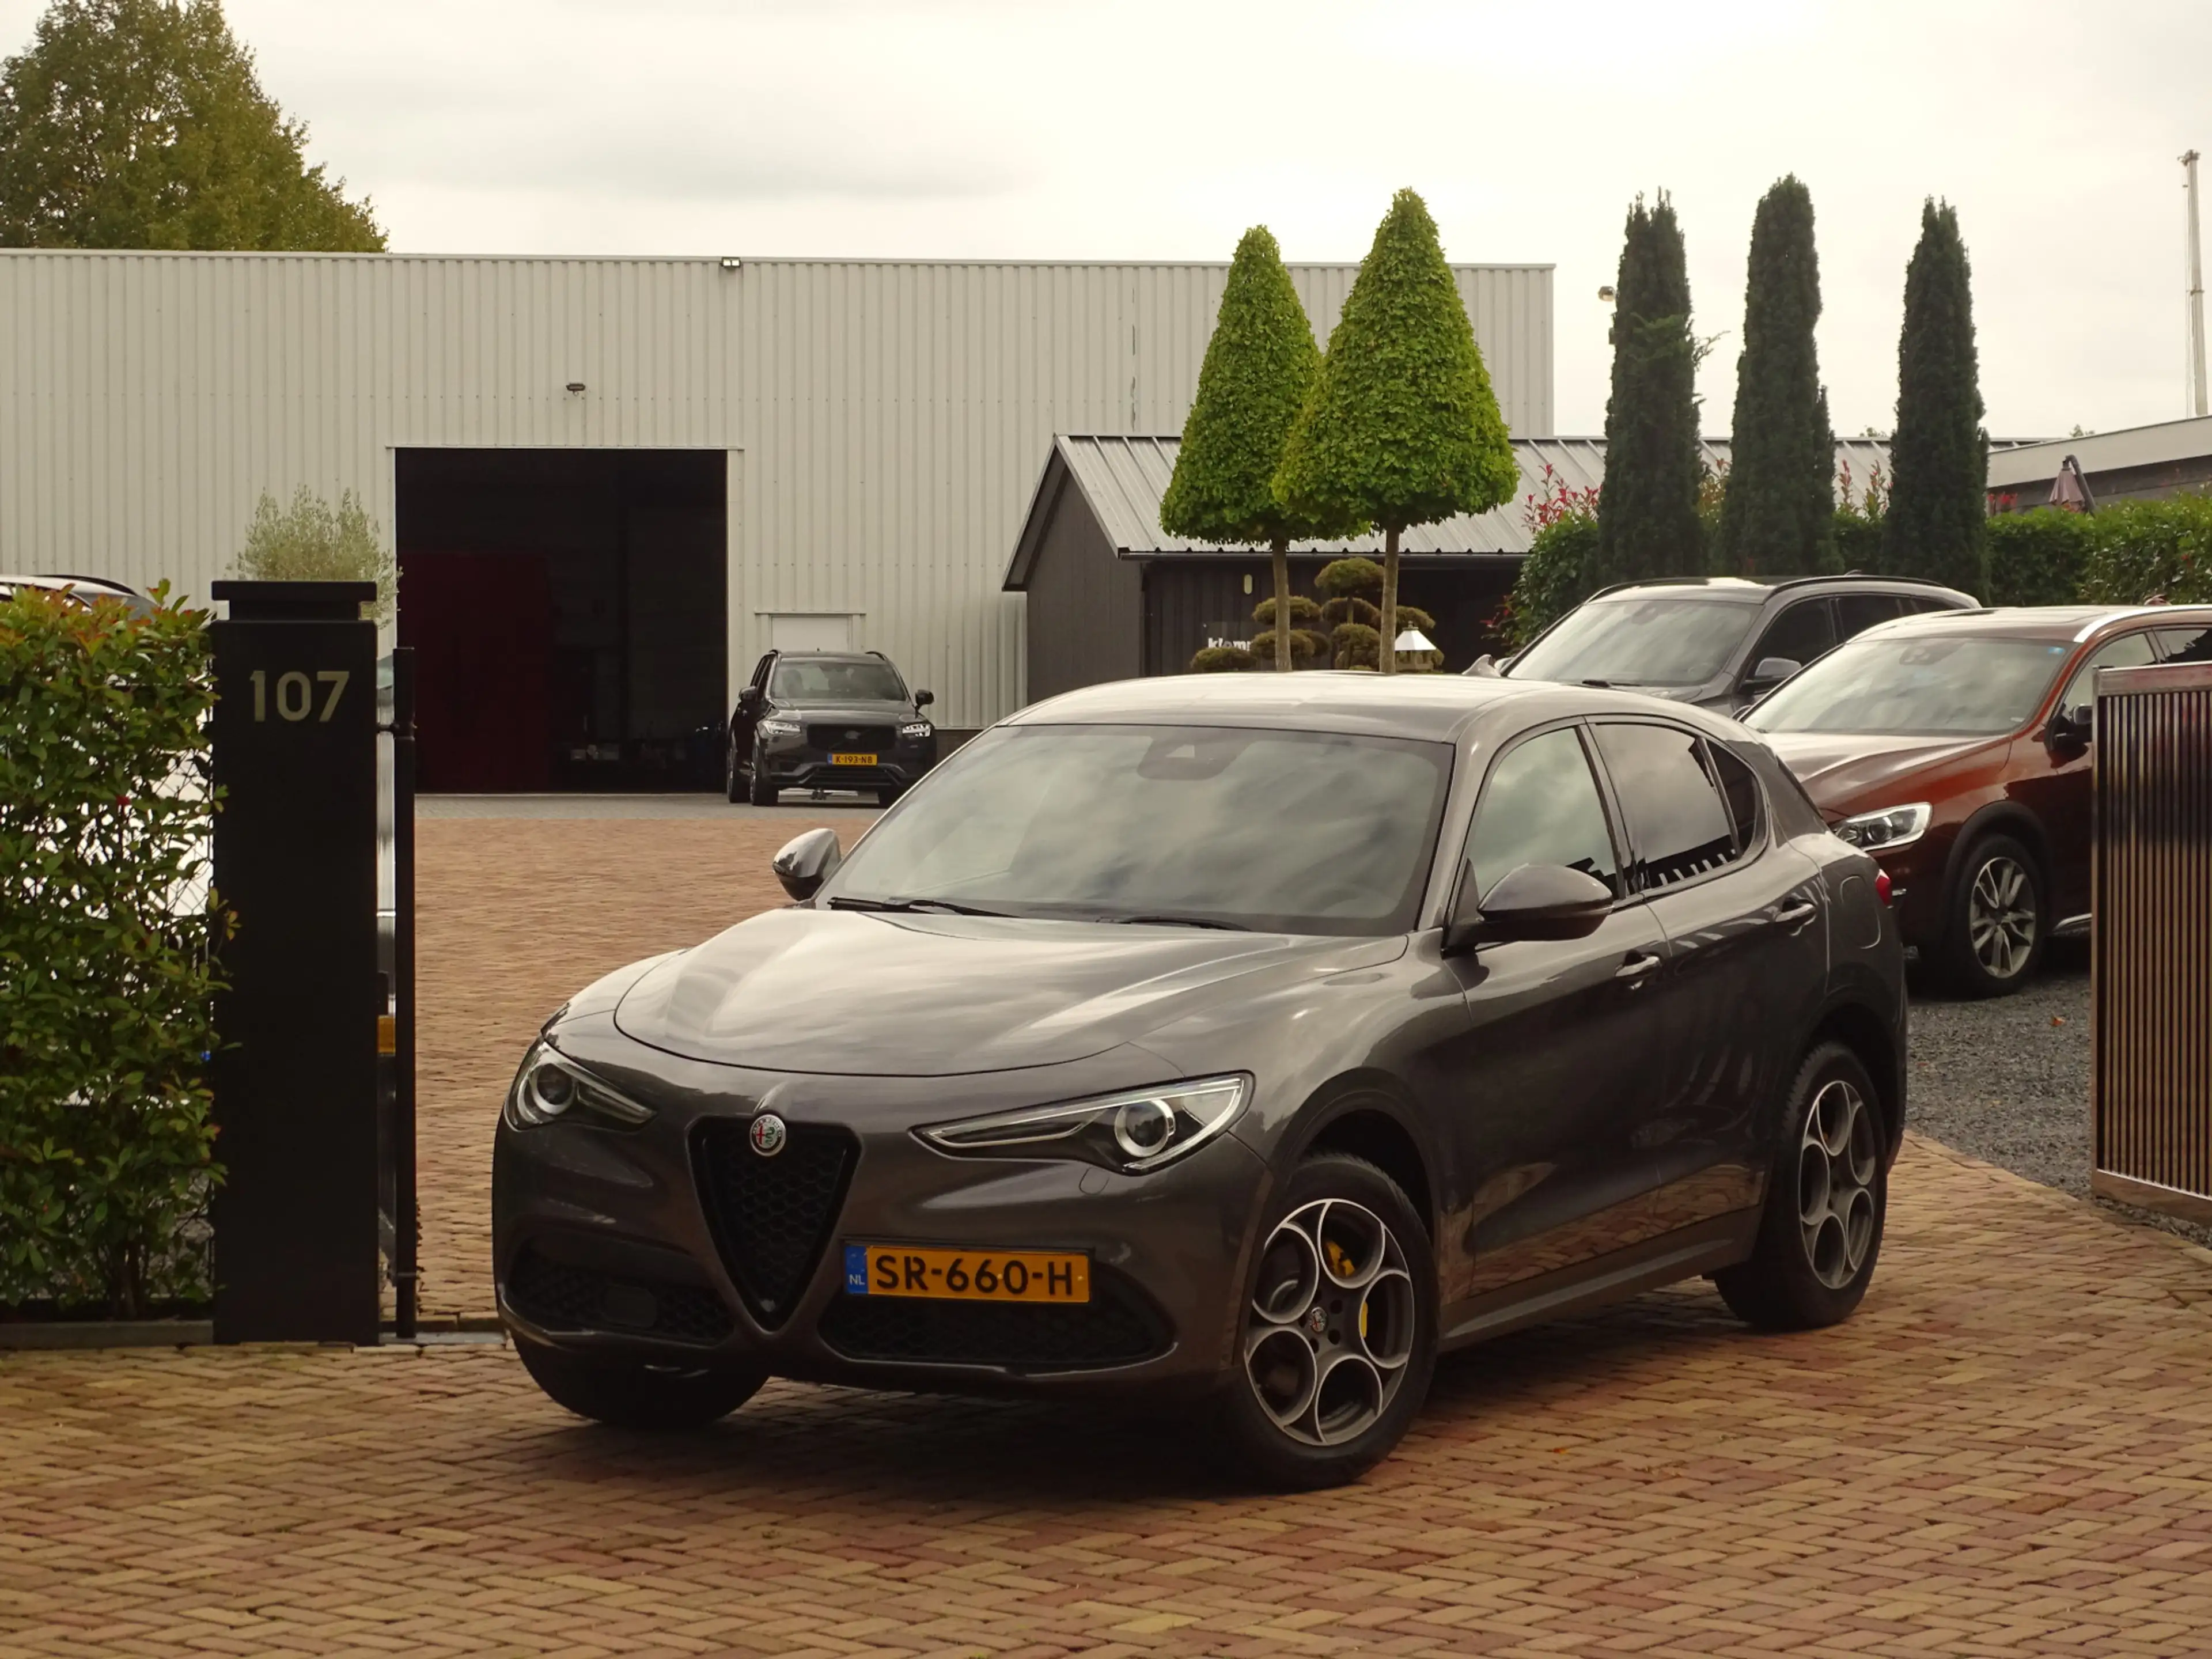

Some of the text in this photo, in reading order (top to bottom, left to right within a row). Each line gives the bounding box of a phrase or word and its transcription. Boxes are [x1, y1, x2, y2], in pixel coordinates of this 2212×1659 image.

[250, 671, 350, 722] 107
[849, 1274, 865, 1286] NL
[875, 1255, 1073, 1296] SR-660-H
